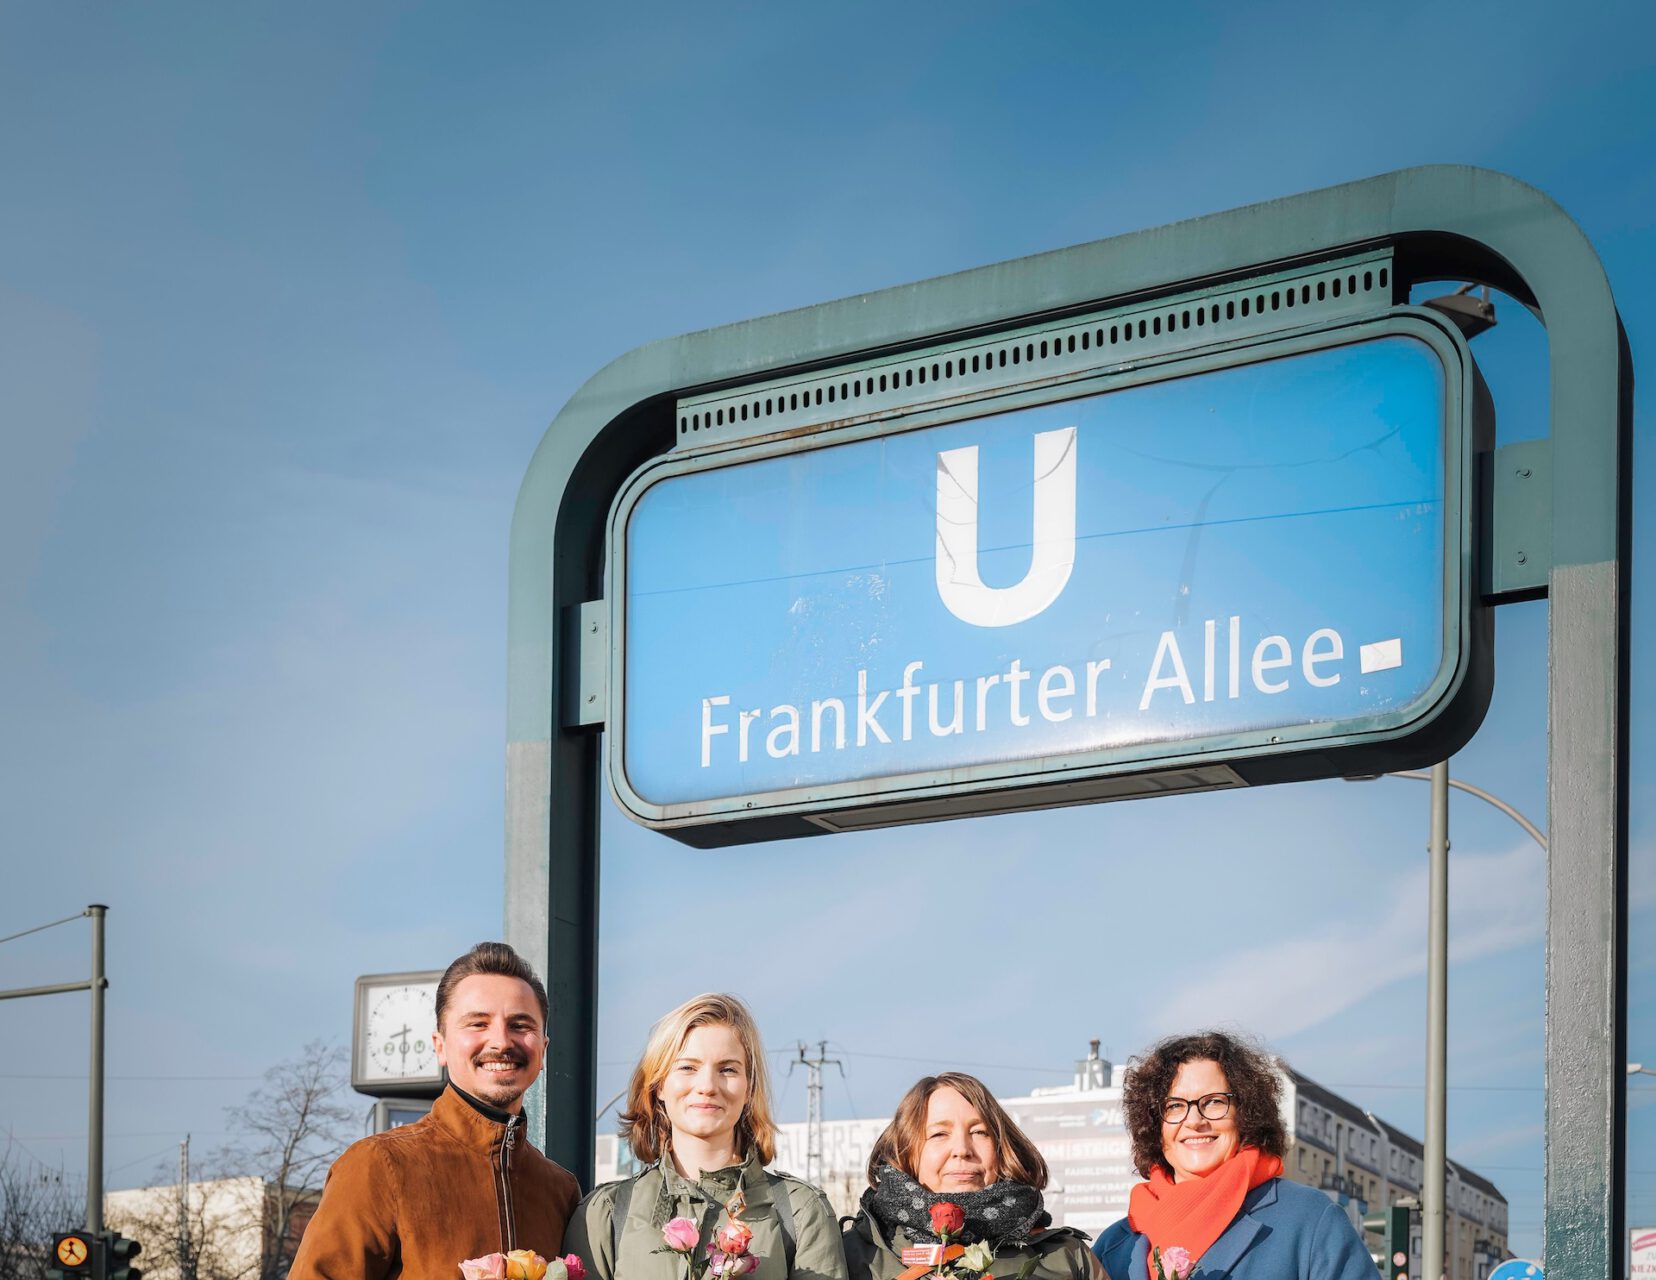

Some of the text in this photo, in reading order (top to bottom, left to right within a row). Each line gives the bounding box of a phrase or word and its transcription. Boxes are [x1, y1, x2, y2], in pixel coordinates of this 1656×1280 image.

[936, 426, 1077, 628] U
[701, 616, 1344, 768] Frankfurter Allee
